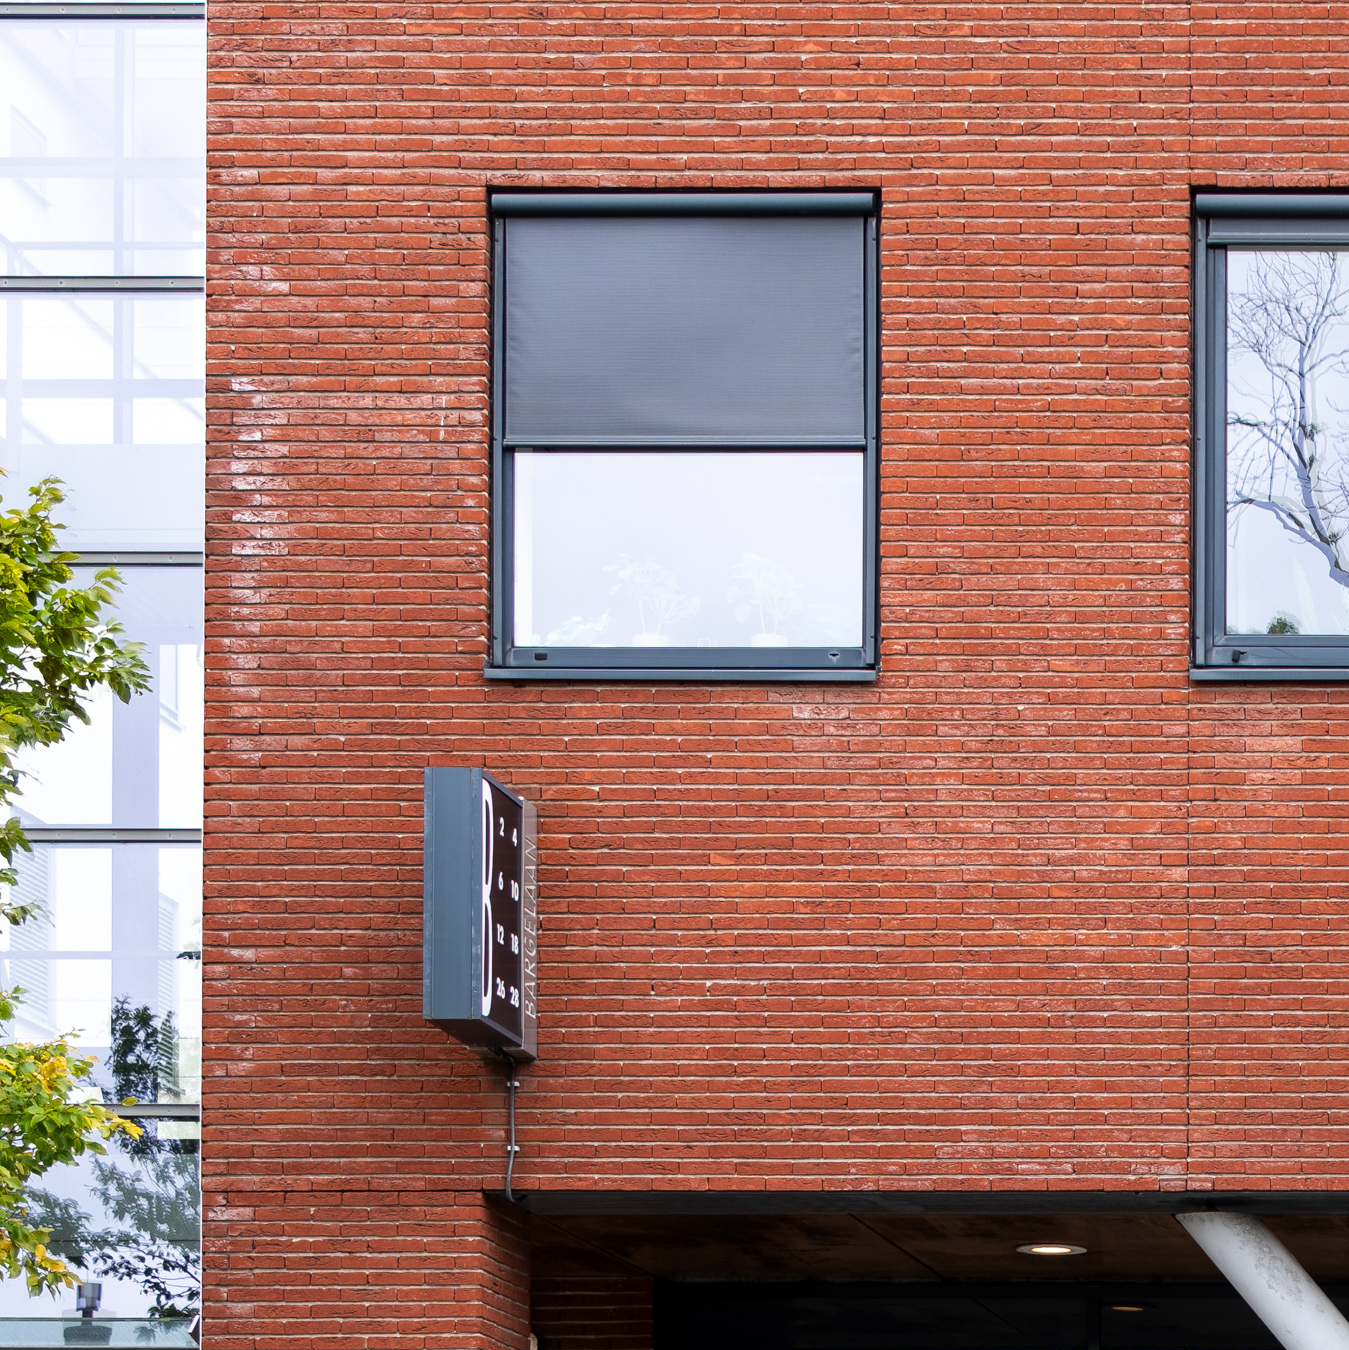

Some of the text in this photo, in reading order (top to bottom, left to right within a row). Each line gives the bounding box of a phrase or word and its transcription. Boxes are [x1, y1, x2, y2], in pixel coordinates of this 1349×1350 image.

[500, 816, 518, 847] 2 4
[498, 871, 519, 901] 6 10
[496, 923, 519, 955] 12 18
[524, 837, 537, 1019] BARGELAAN
[496, 977, 520, 1008] 26 28
